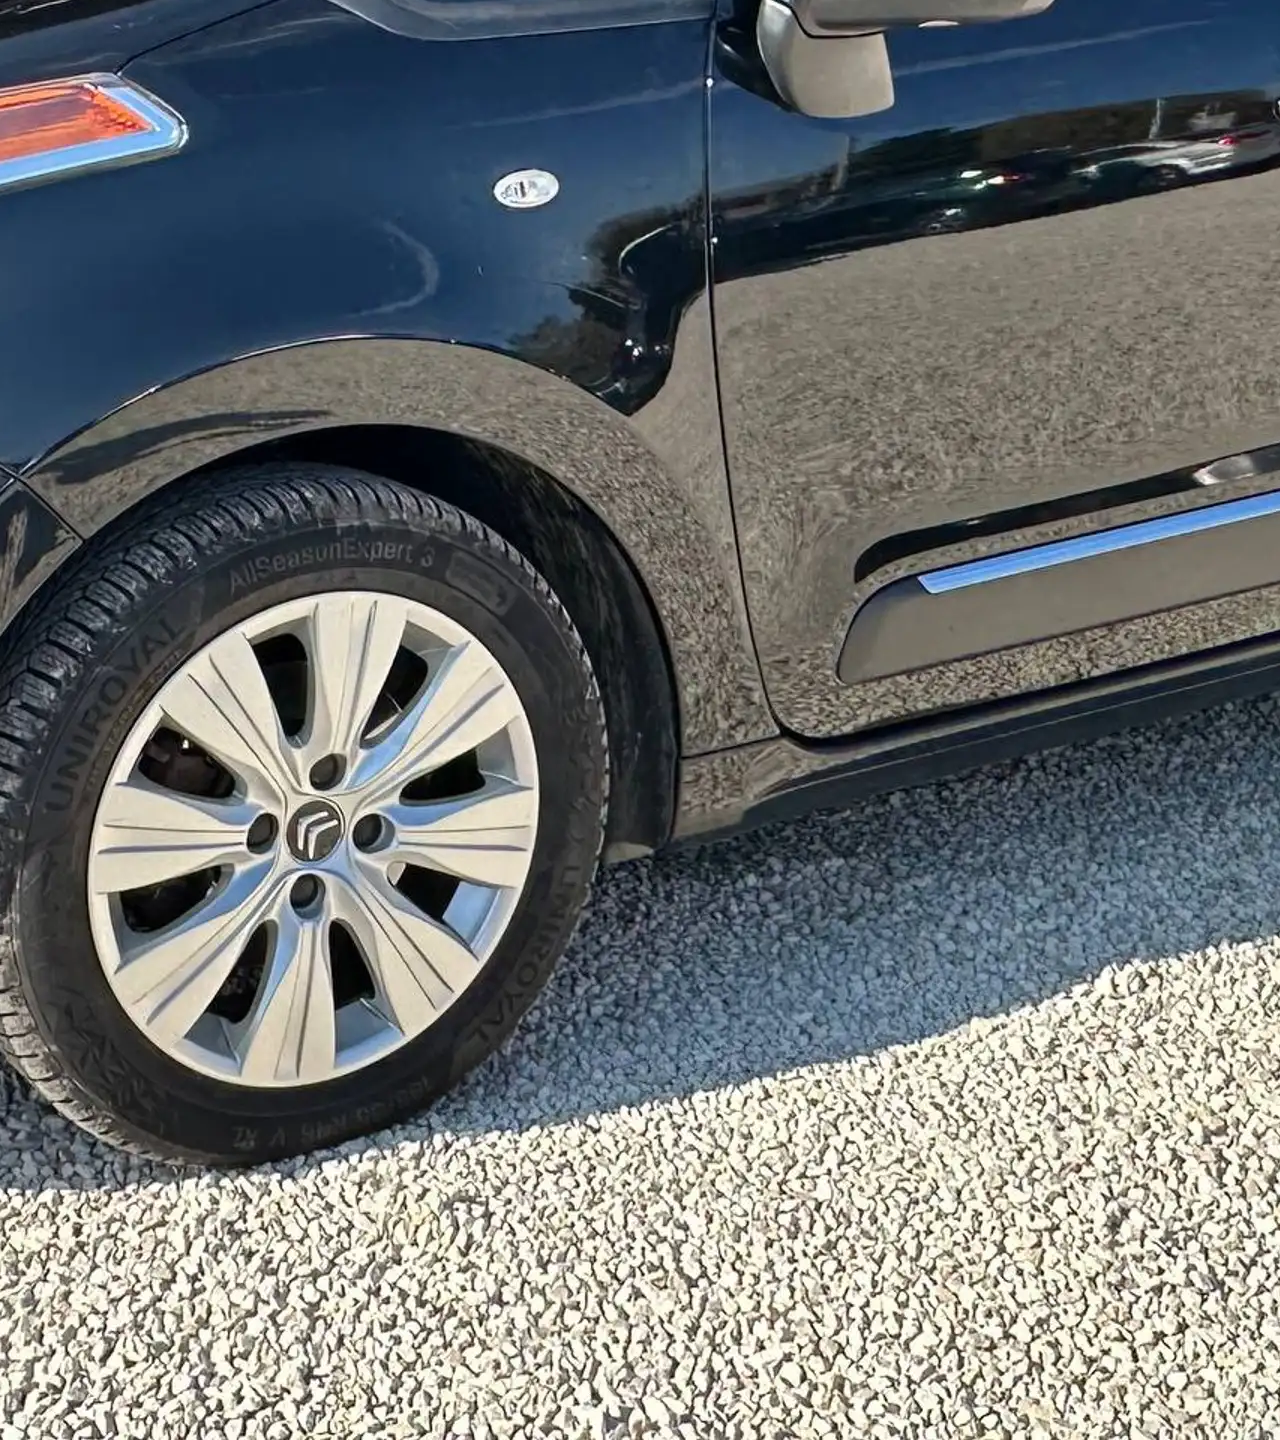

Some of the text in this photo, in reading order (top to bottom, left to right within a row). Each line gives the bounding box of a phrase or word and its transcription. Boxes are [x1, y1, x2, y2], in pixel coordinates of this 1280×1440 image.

[228, 536, 437, 593] AllSeasonExpert 3
[44, 615, 186, 813] UNIROYAL
